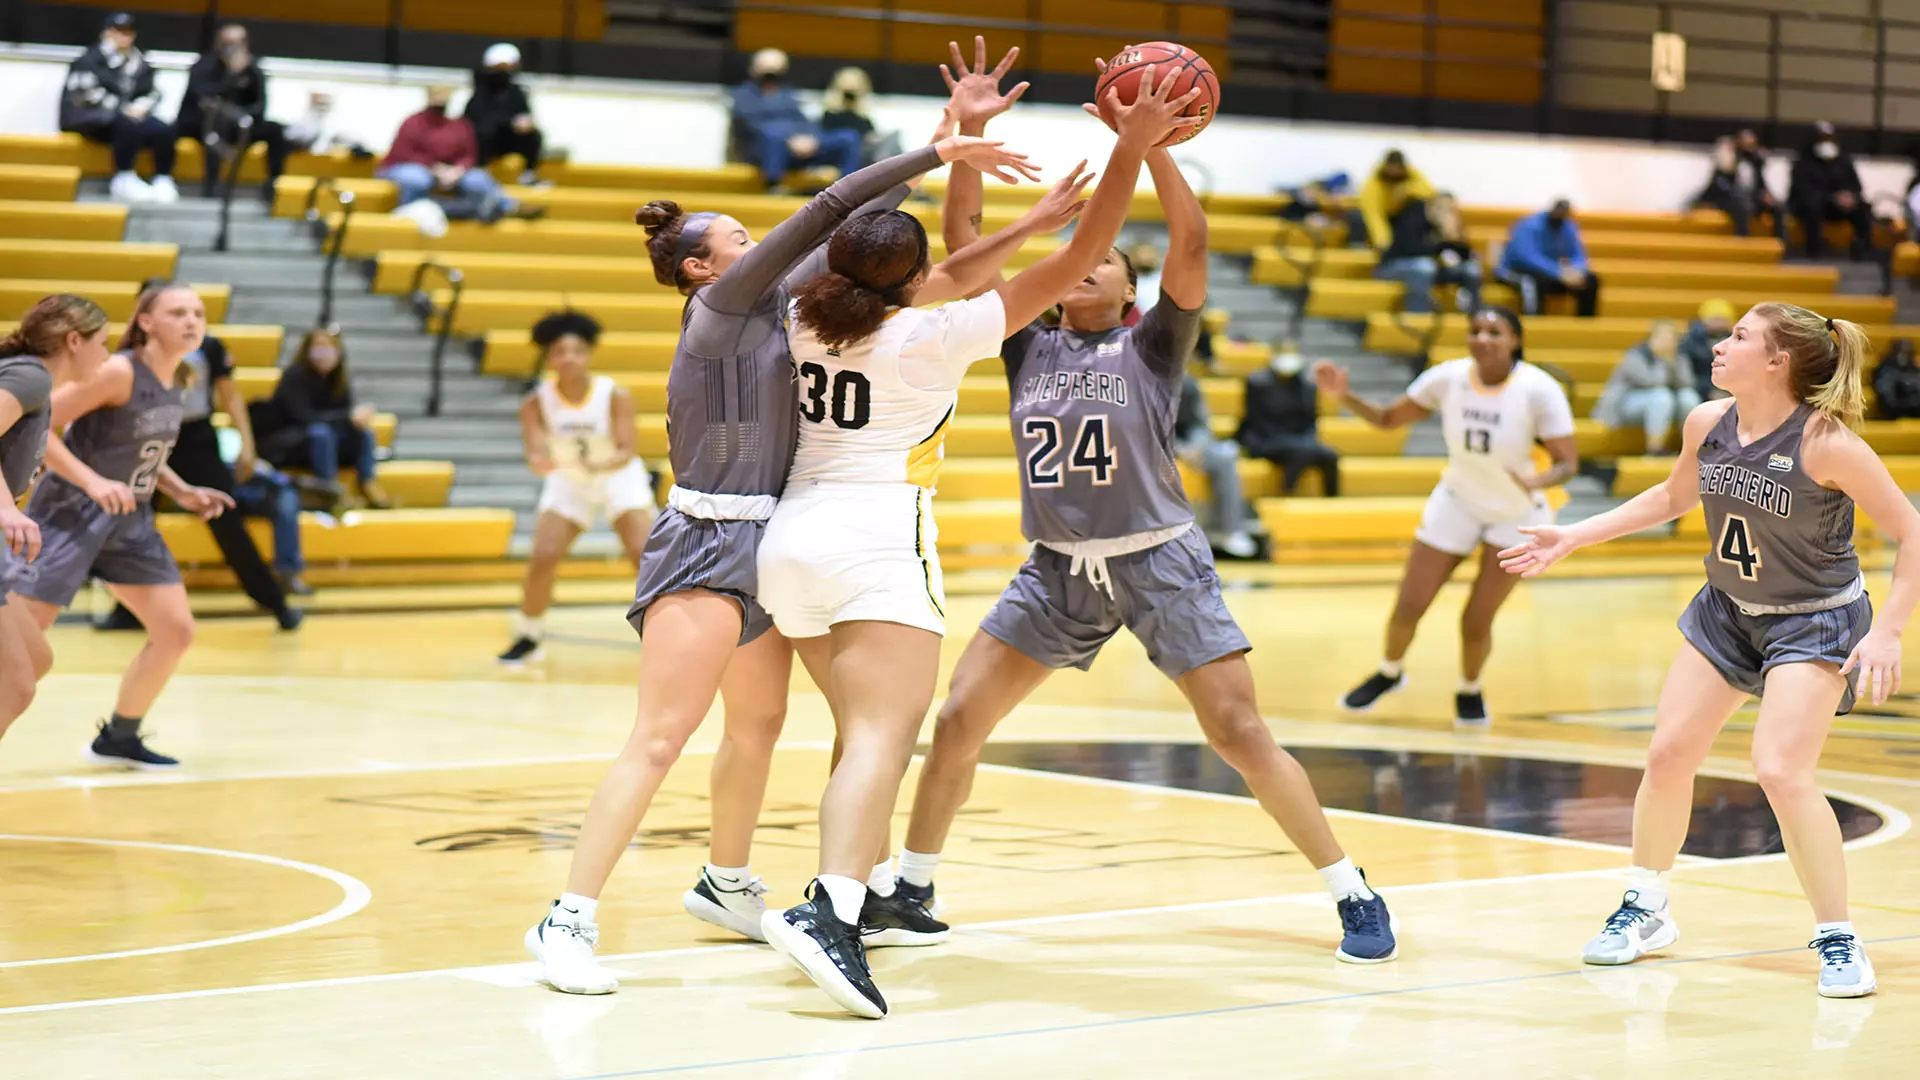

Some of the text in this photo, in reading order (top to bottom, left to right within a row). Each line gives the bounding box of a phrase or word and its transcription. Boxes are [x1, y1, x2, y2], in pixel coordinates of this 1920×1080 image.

[799, 361, 871, 430] 30
[1022, 414, 1118, 488] 24
[1698, 463, 1793, 519] HEPHERD
[1716, 512, 1763, 582] 4
